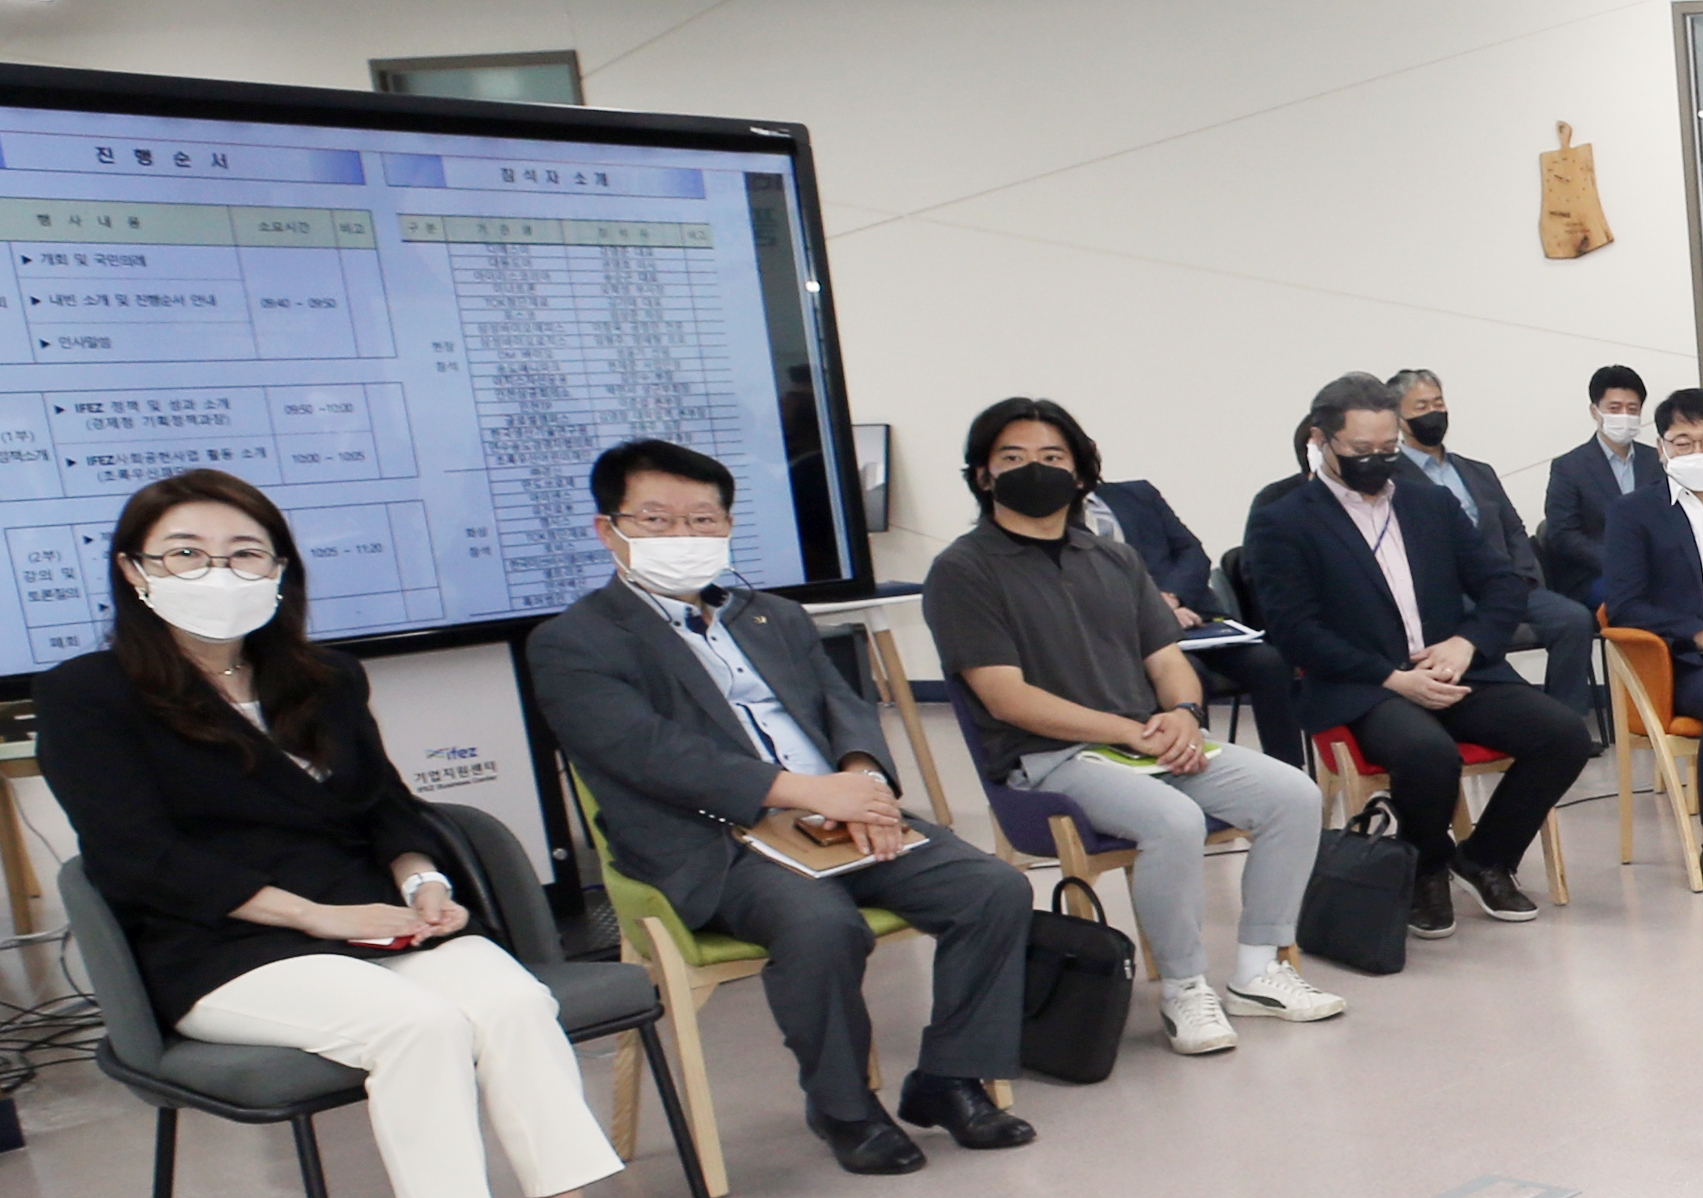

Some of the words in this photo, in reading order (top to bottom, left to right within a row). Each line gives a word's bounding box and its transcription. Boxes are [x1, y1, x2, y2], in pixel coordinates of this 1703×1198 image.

[74, 253, 88, 266] 및
[94, 253, 146, 267] 국민의례
[84, 294, 110, 306] 소개
[115, 294, 129, 306] 및
[75, 402, 104, 413] IFEZ
[446, 746, 478, 760] ifez
[414, 760, 498, 784] 기업지원센터
